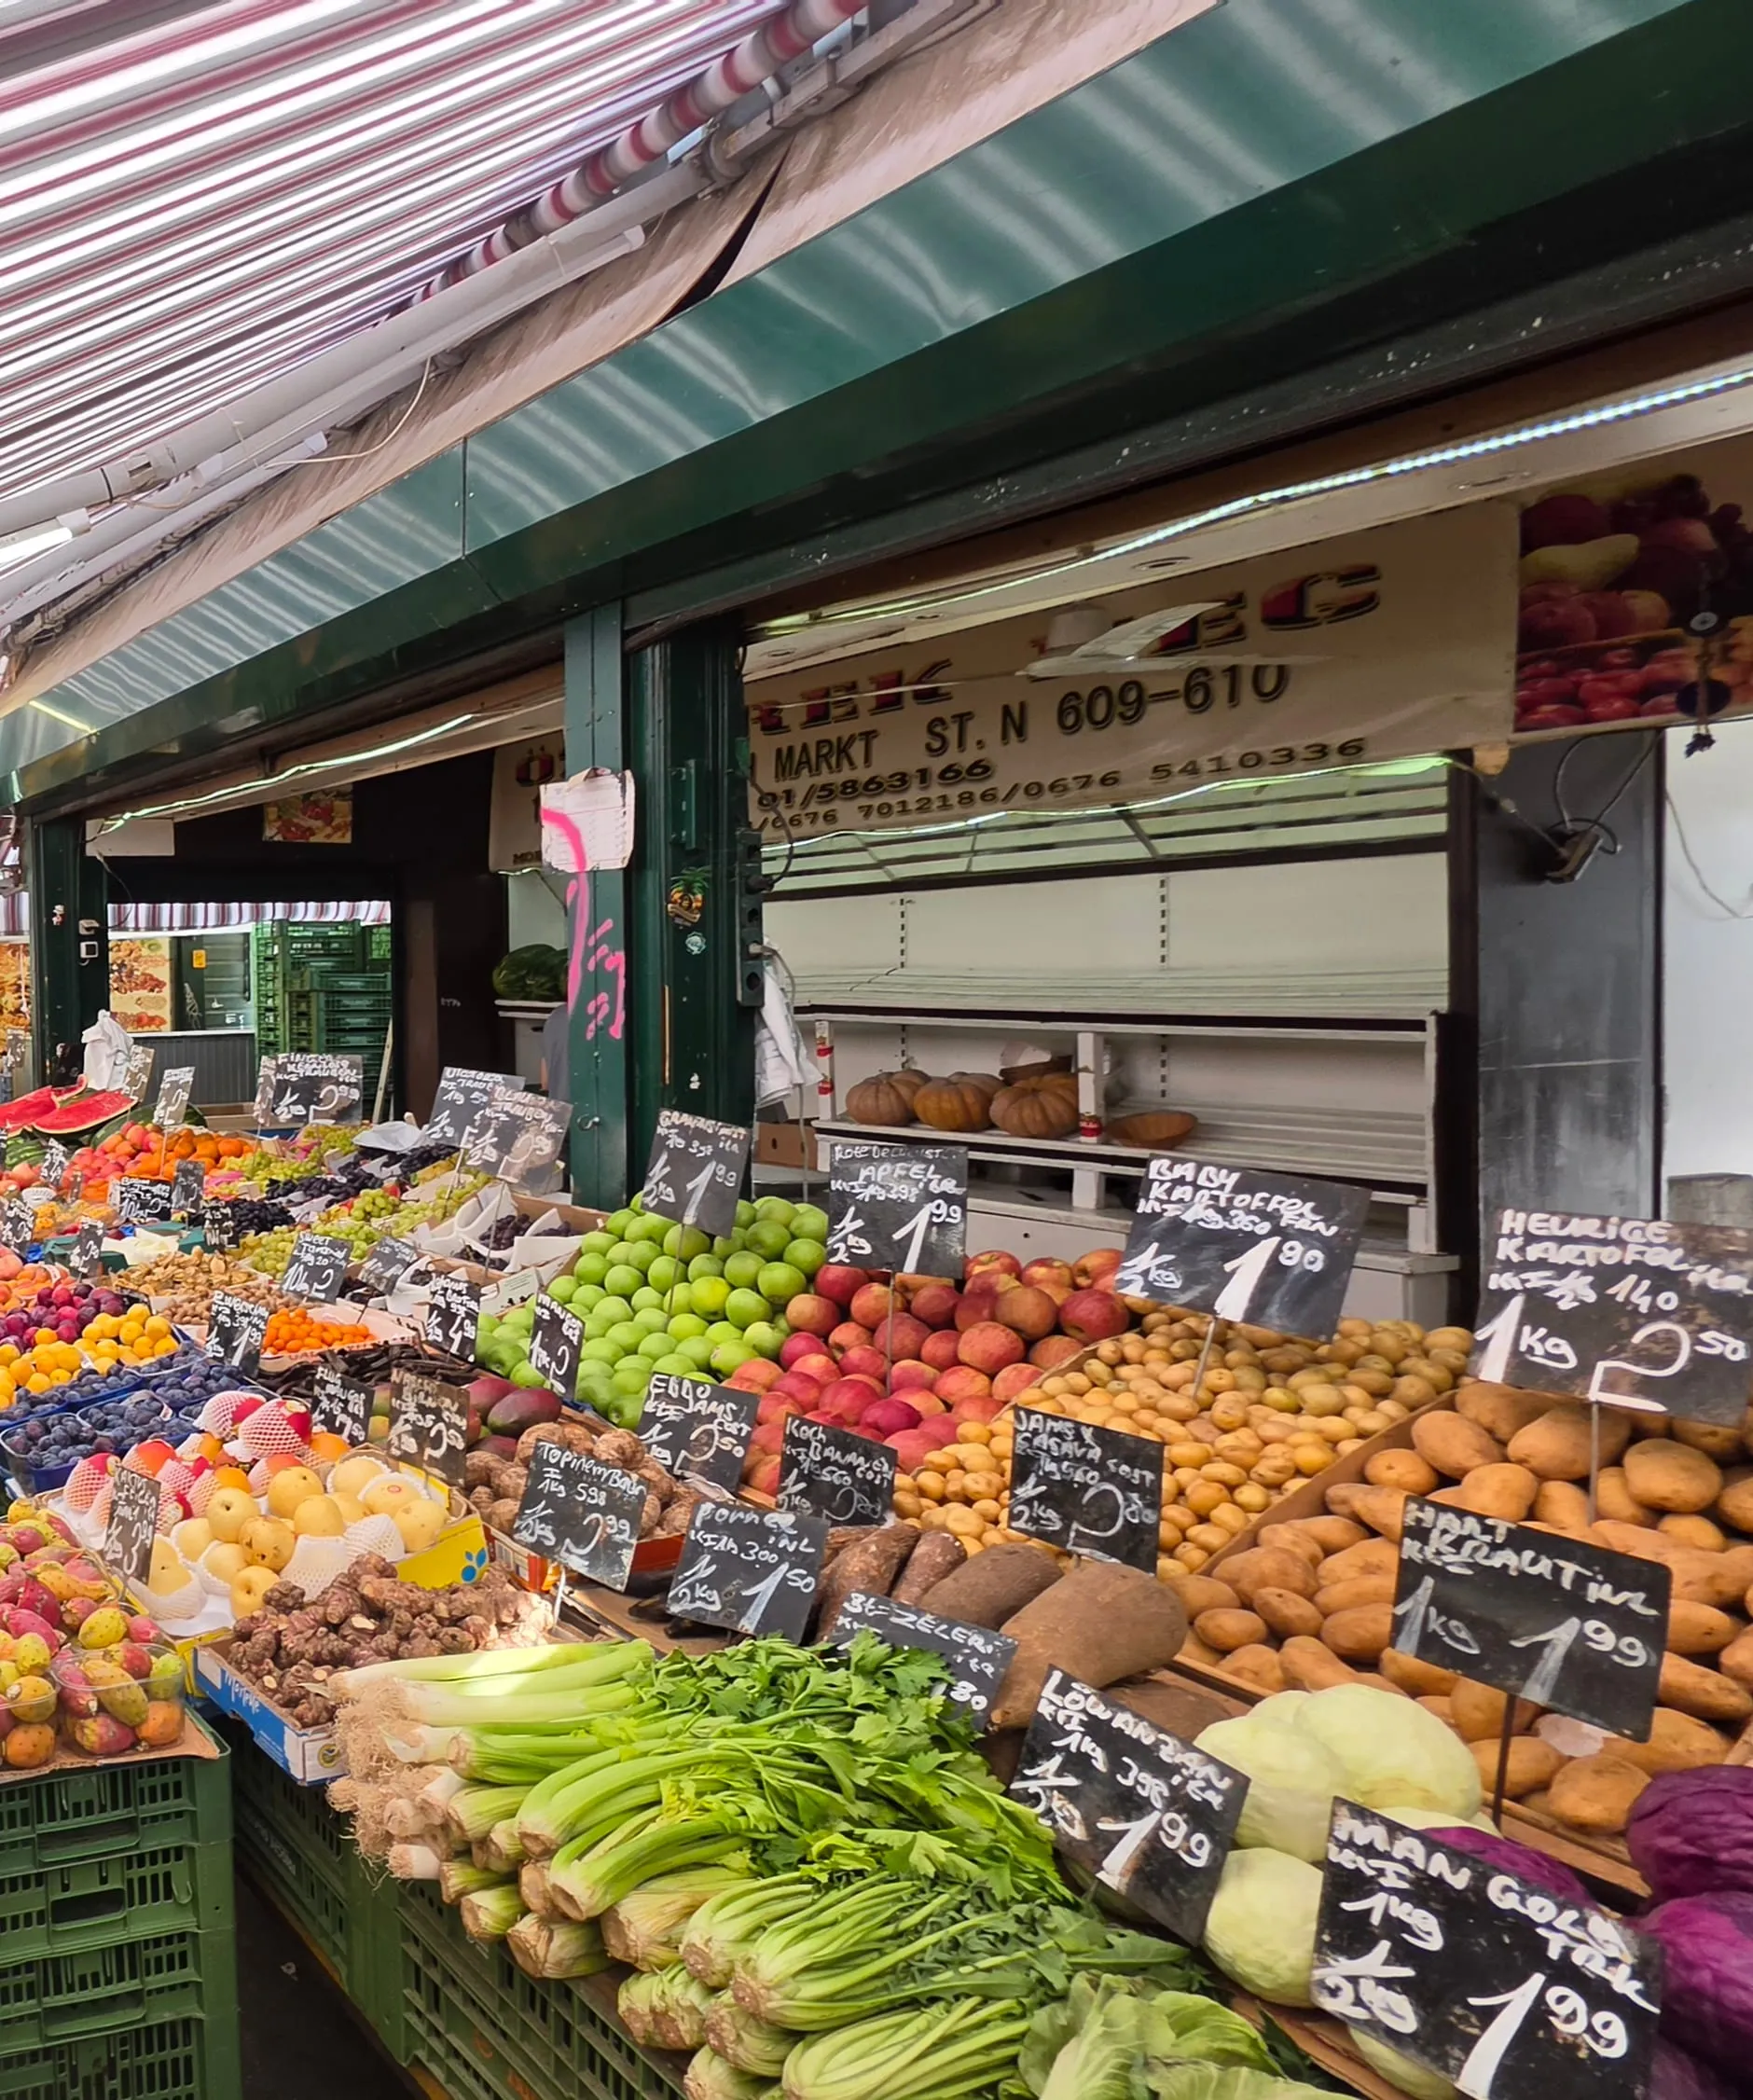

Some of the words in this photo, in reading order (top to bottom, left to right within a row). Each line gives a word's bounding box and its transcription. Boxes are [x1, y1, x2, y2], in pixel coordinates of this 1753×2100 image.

[774, 728, 880, 782] MARKT
[1001, 700, 1028, 745] N
[1151, 737, 1368, 781] 5410336
[757, 758, 994, 810] 01/5863166
[1148, 1158, 1241, 1195] BABY
